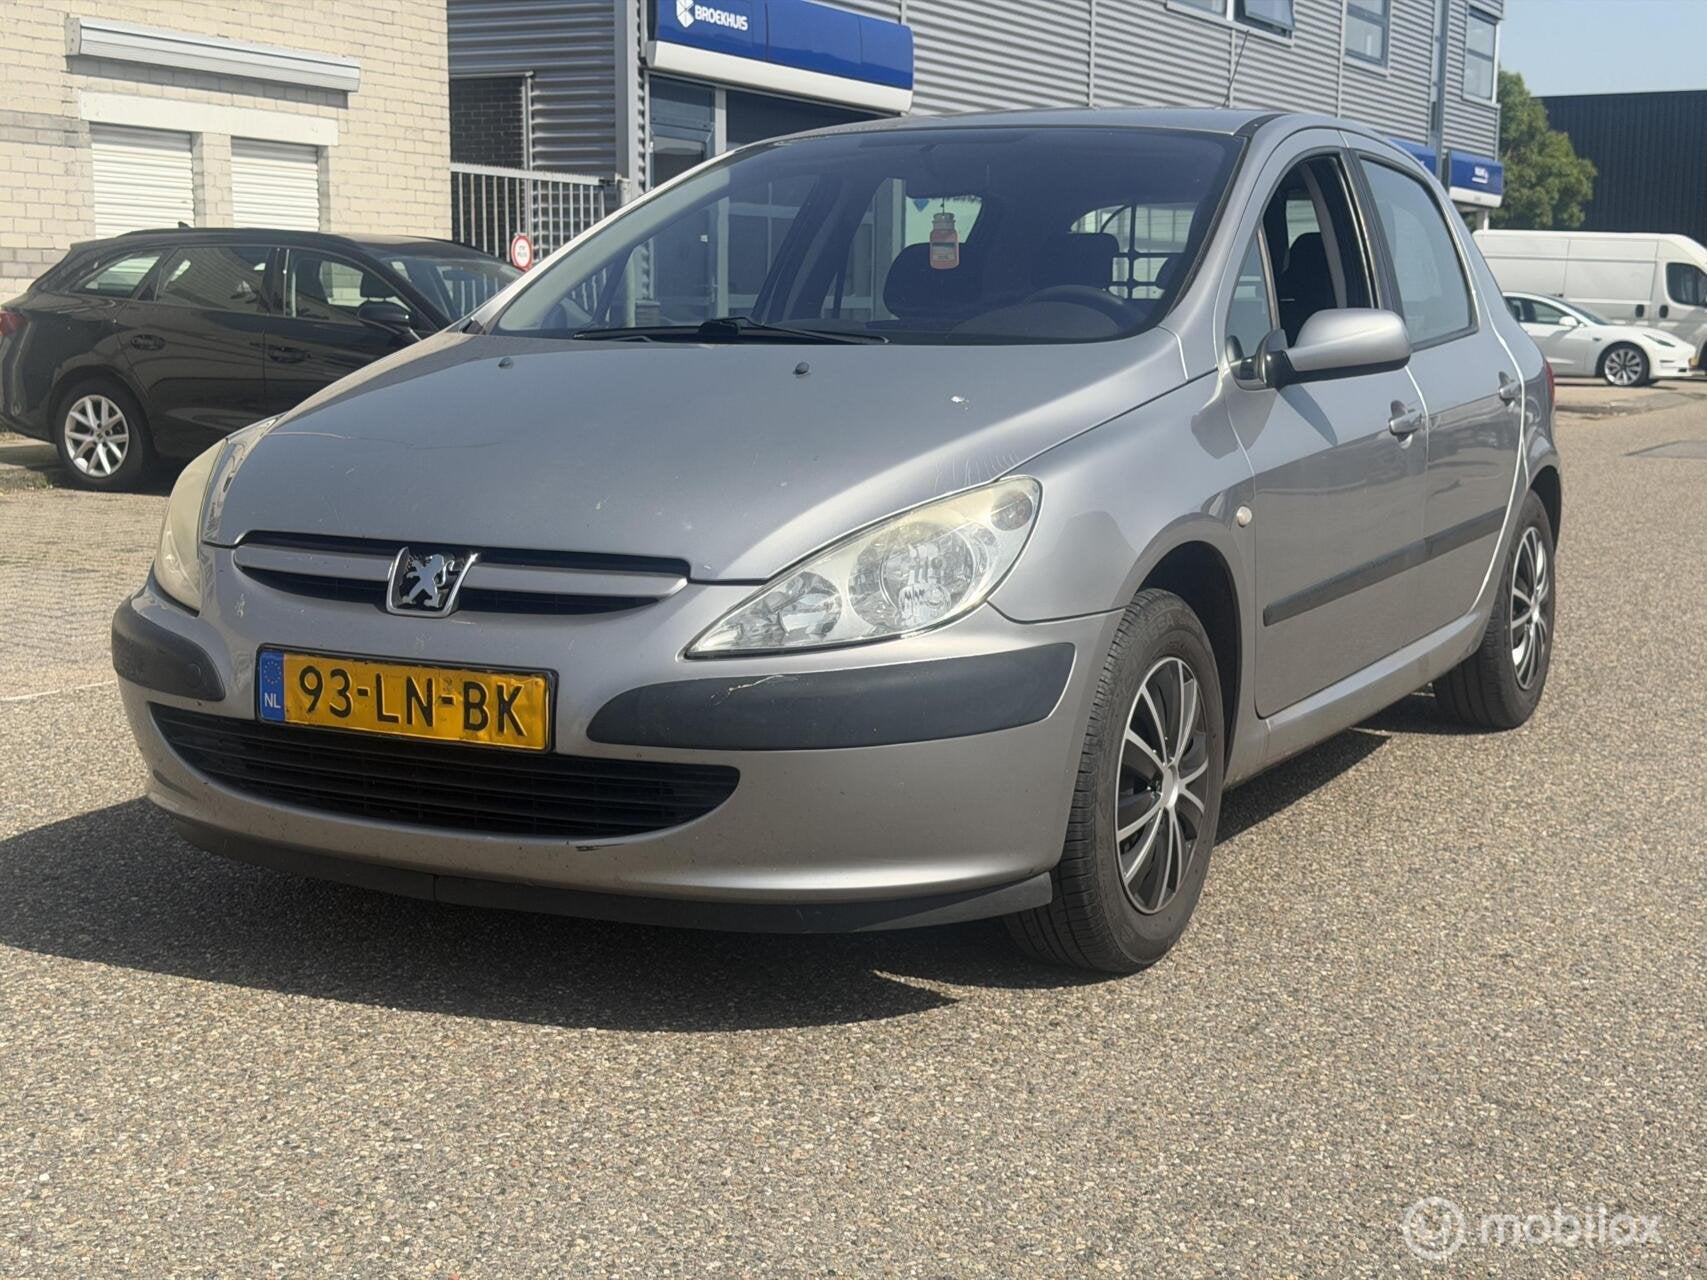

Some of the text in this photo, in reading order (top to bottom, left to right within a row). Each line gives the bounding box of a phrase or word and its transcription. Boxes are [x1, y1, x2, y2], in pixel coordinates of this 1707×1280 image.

[694, 5, 748, 31] BROEKHUIS
[264, 693, 281, 709] NL
[299, 665, 527, 737] 93-LN-BK
